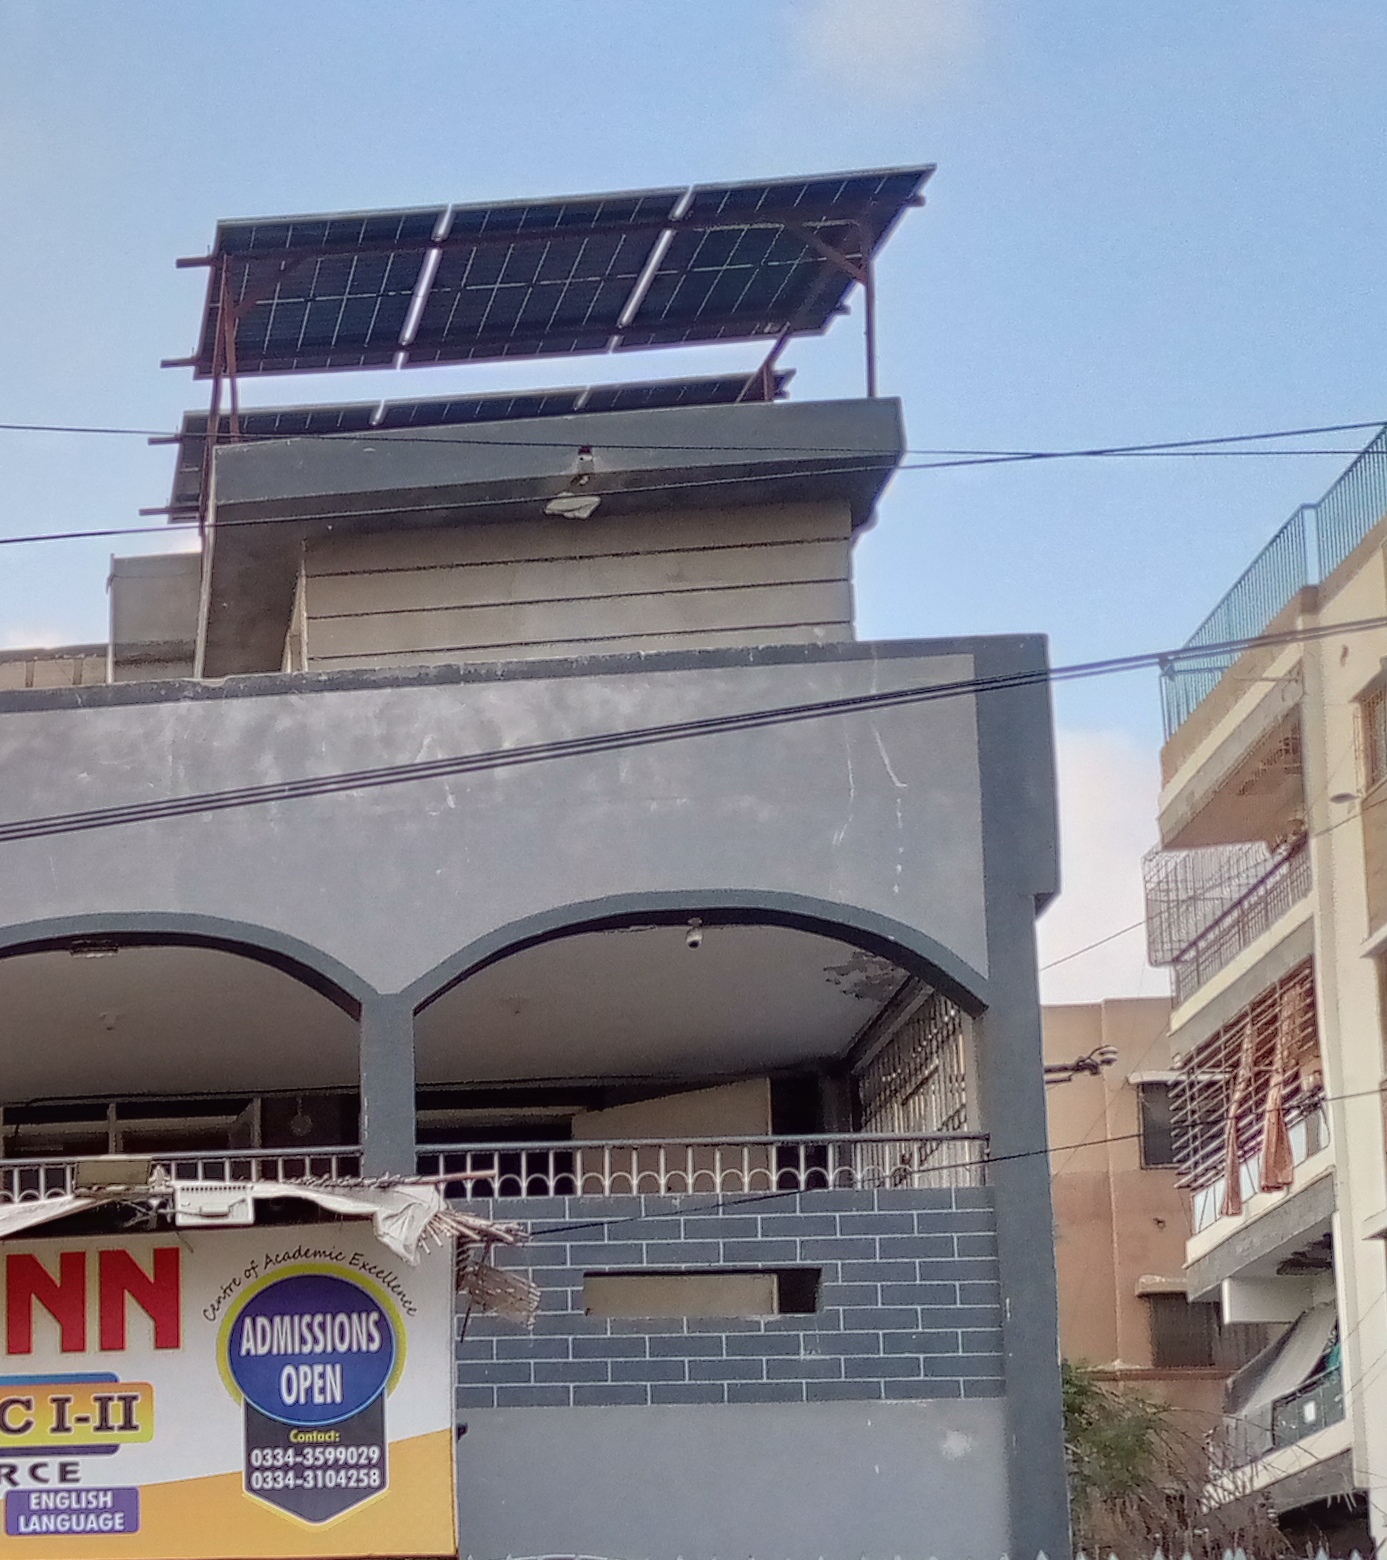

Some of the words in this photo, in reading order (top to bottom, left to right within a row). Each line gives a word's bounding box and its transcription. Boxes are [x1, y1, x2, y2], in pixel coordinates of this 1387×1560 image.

[202, 1276, 242, 1322] Centre
[243, 1260, 260, 1280] of
[263, 1245, 346, 1270] Academic
[348, 1252, 418, 1318] Excellence
[239, 1310, 382, 1359] ADMISSIONS
[280, 1363, 344, 1406] OPEN
[49, 1392, 139, 1434] I-II
[289, 1428, 341, 1443] Contact:
[250, 1446, 379, 1468] 0334-3599029
[251, 1469, 381, 1490] 0334-3104258
[28, 1490, 112, 1511] ENGLISH
[18, 1511, 125, 1533] LANGUAGE
